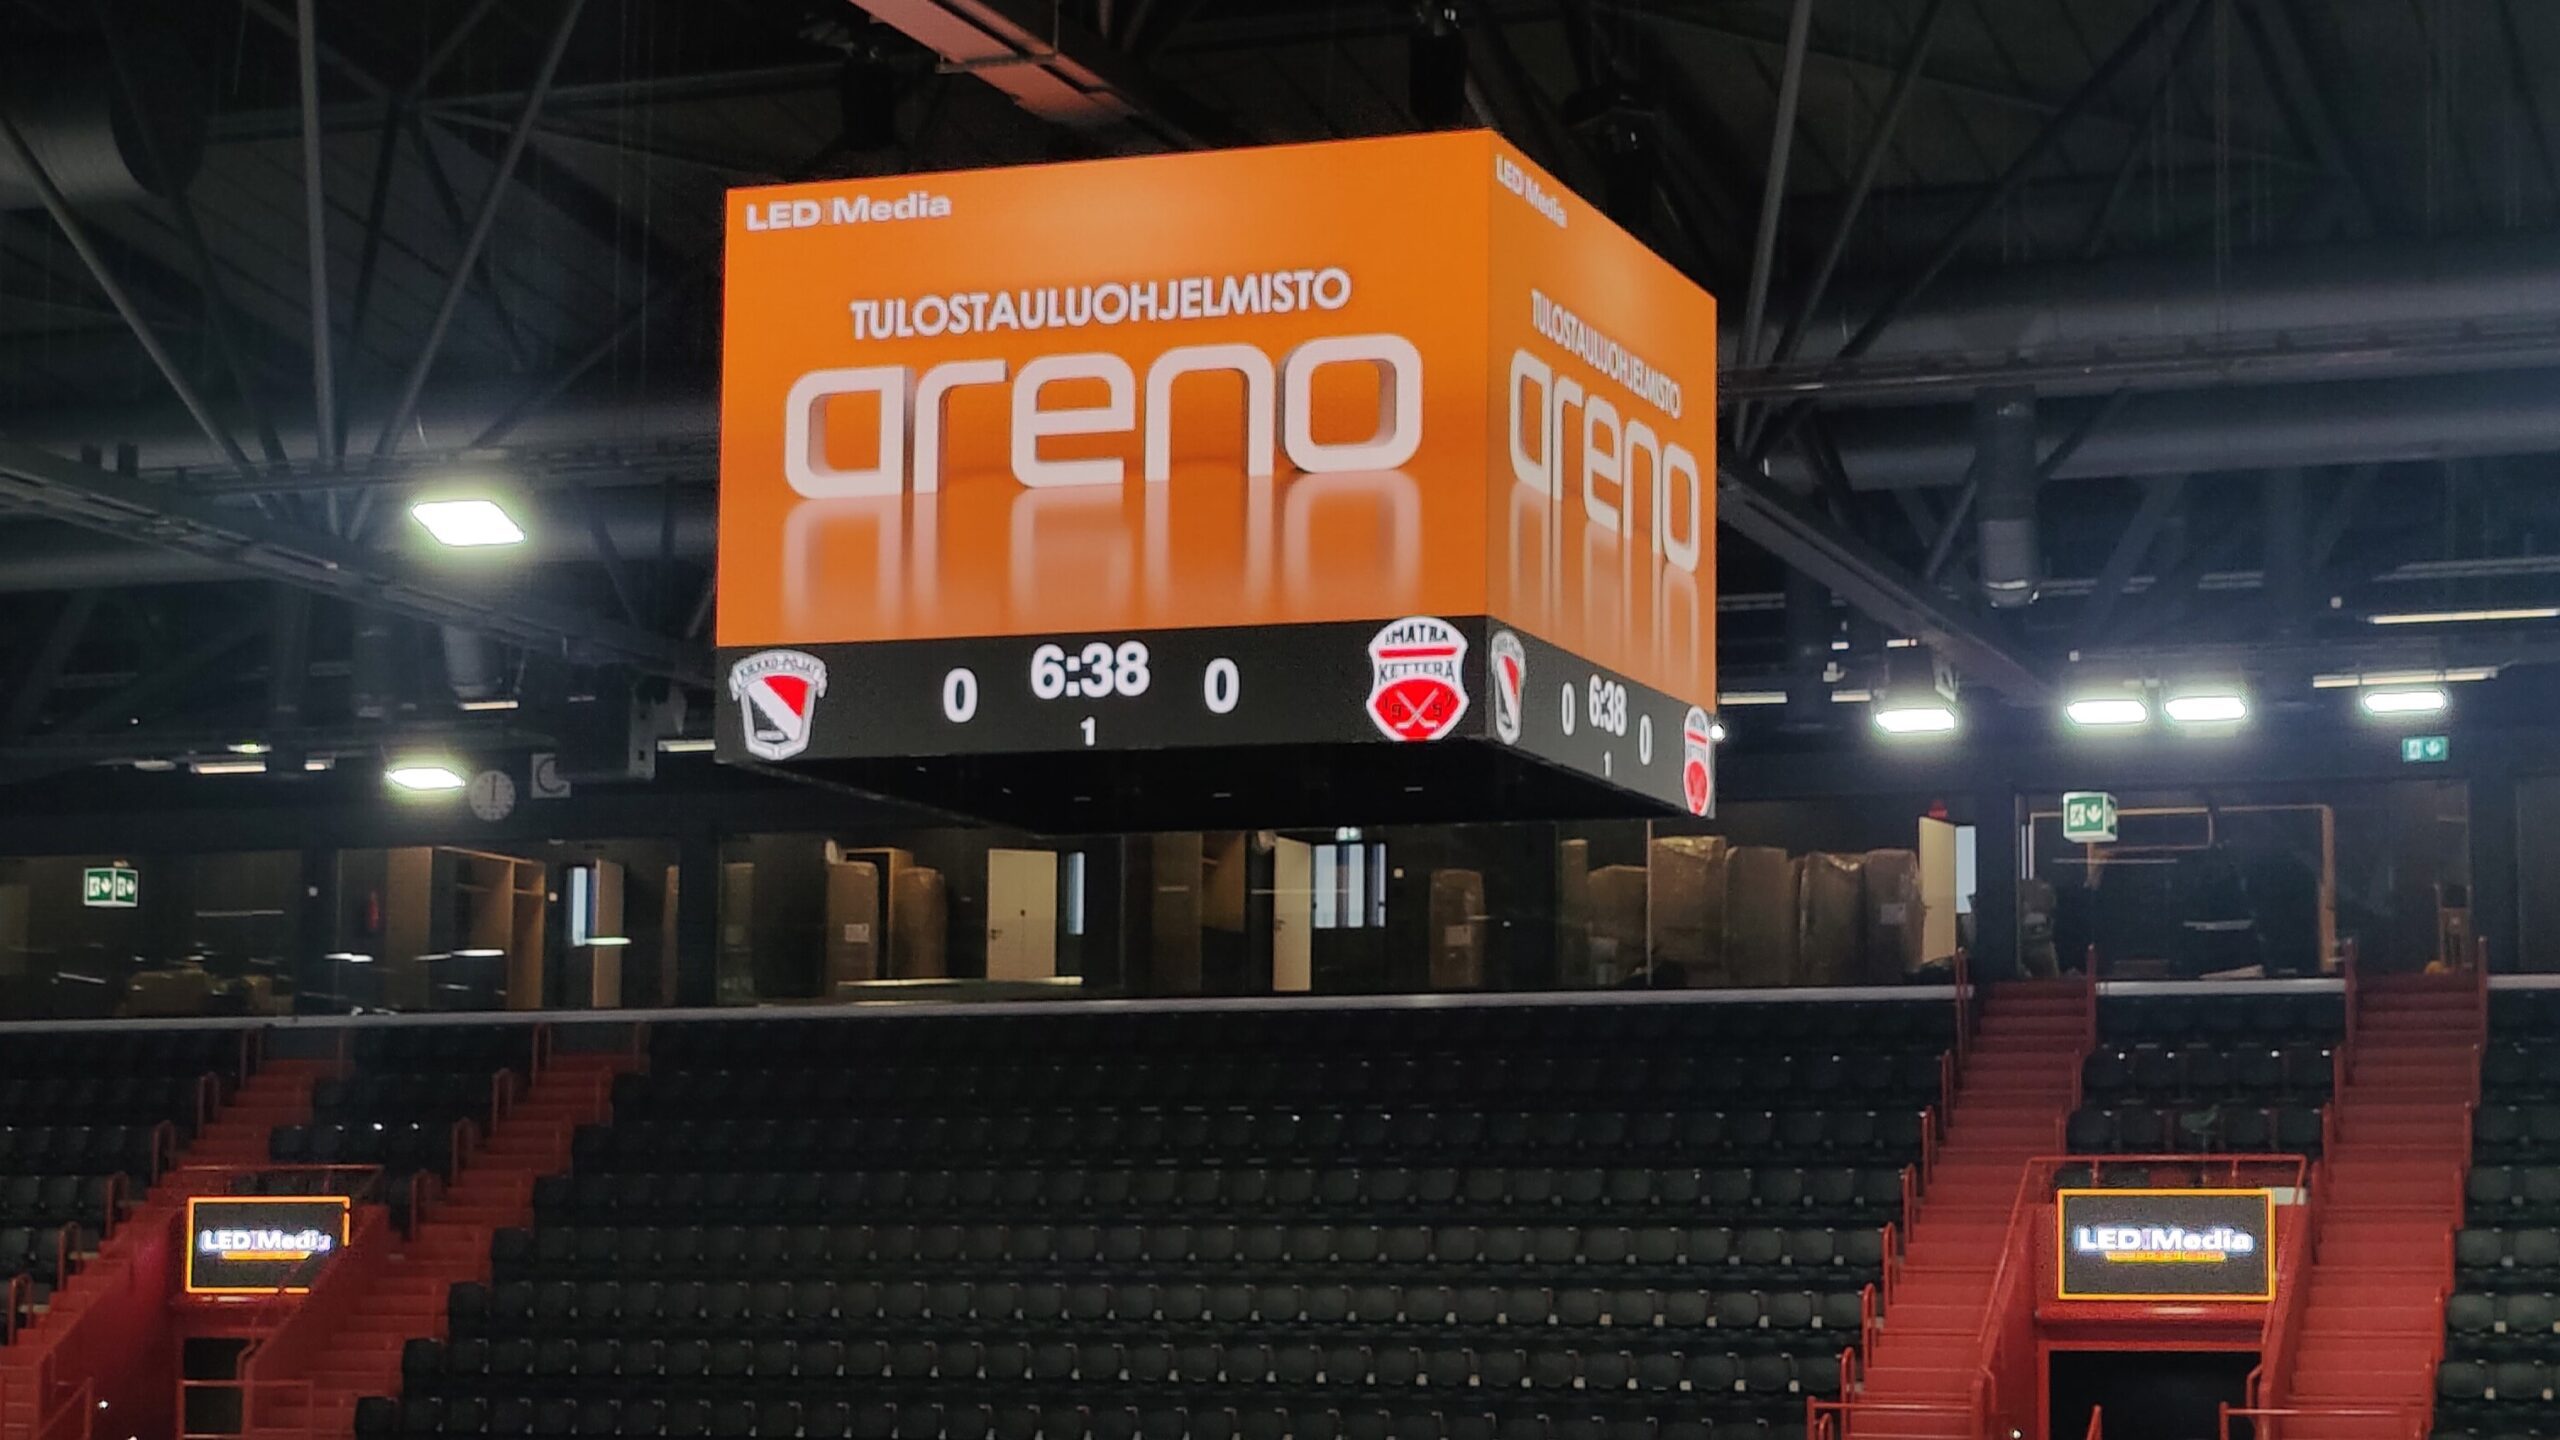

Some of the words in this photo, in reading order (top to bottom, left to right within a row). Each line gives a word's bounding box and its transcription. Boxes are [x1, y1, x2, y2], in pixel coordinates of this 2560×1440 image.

[745, 199, 822, 232] LED
[832, 191, 952, 225] Media
[850, 267, 1353, 341] TULOSTAULUOHJELMISTO
[785, 333, 1423, 500] areno
[1509, 348, 1699, 574] areno
[942, 667, 978, 724] 0
[1030, 640, 1151, 700] 6:38
[1204, 657, 1241, 714] 0
[1079, 716, 1097, 747] 1
[1561, 682, 1576, 736] 0
[1588, 673, 1628, 737] 6:38
[1603, 751, 1612, 778] 1
[1639, 714, 1653, 766] 0
[200, 1229, 251, 1252] LED
[2077, 1227, 2142, 1251] LED
[2150, 1227, 2254, 1252] Media
